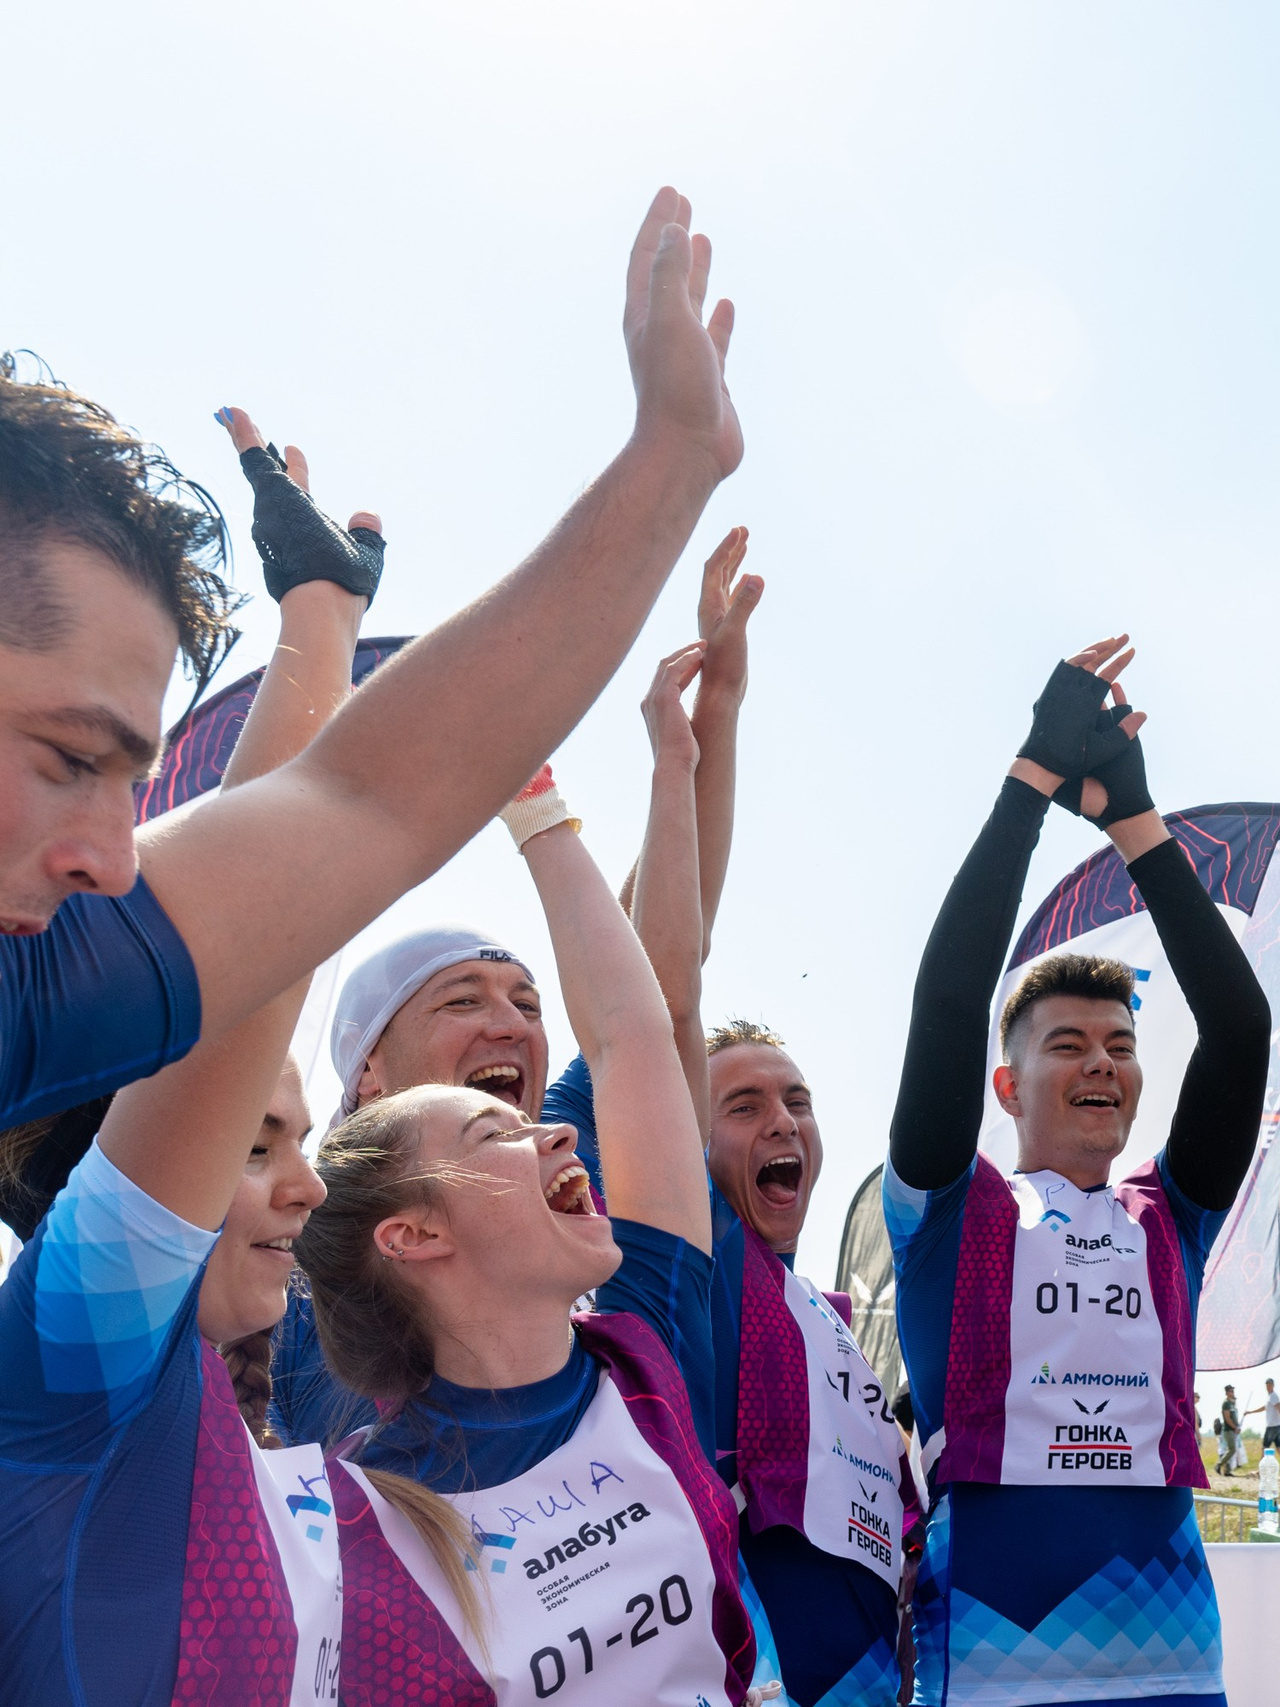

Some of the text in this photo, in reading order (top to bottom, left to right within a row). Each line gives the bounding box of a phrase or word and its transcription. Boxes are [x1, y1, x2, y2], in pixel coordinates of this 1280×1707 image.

[480, 950, 512, 962] FILA
[1065, 1234, 1138, 1254] алабга
[1036, 1283, 1141, 1319] 01-20
[1062, 1372, 1149, 1388] АММОНИЙ
[1055, 1425, 1128, 1443] ГОНКА
[1048, 1453, 1133, 1470] ГЕРОЕВ
[851, 1501, 890, 1539] ГОНКА
[523, 1502, 651, 1580] алабуга
[848, 1526, 891, 1567] ГЕРОЕВ
[537, 1575, 570, 1596] ОСОБАЯ
[541, 1561, 611, 1605] ЭКОНОМИЧЕСКАЯ
[546, 1596, 569, 1612] ЗОНА
[530, 1574, 693, 1699] 01-20
[315, 1637, 341, 1699] 01-2
